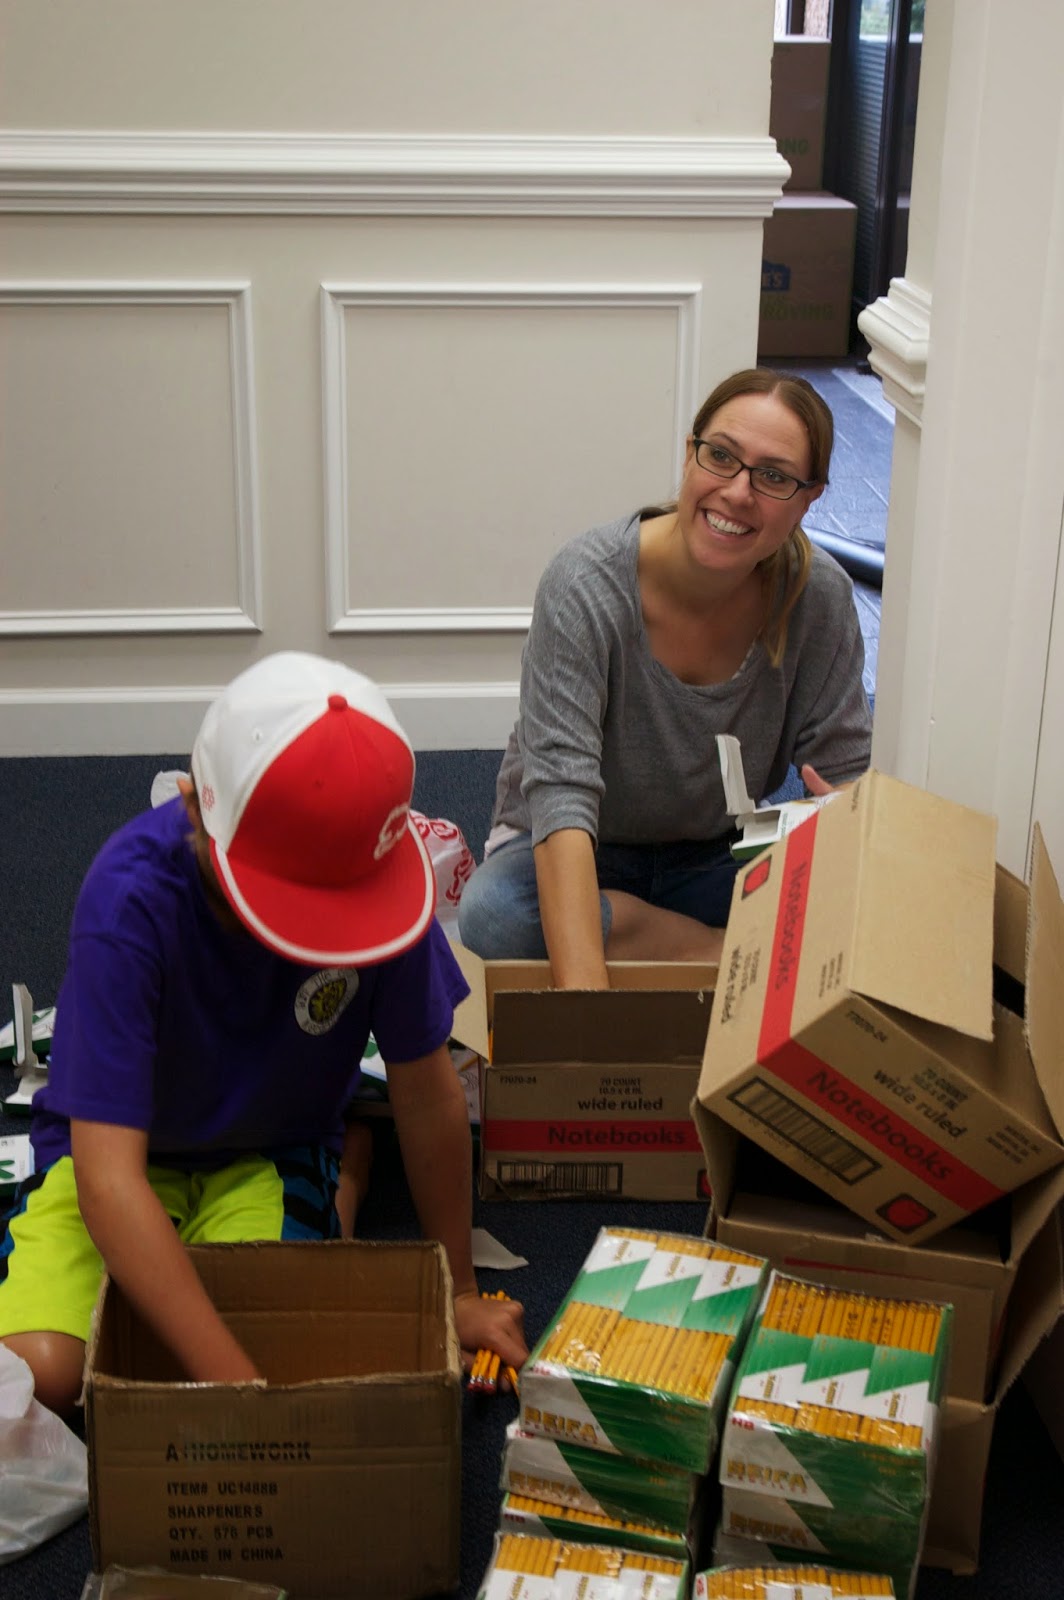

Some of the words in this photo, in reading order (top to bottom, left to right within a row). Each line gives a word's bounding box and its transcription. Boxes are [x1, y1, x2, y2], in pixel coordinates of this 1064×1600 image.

[577, 1098, 617, 1112] wide
[620, 1097, 664, 1112] ruled
[873, 1068, 917, 1105] wide
[915, 1101, 968, 1138] ruled
[806, 1069, 952, 1181] Notebooks
[548, 1125, 686, 1146] Notebooks
[726, 1457, 808, 1493] BEIFA
[166, 1481, 209, 1496] ITEM#
[167, 1504, 264, 1519] SHARPENERS
[168, 1526, 203, 1541] QTY.
[246, 1525, 274, 1539] PCS
[169, 1549, 209, 1563] MADE
[217, 1548, 233, 1561] IN
[240, 1546, 285, 1561] CHINA
